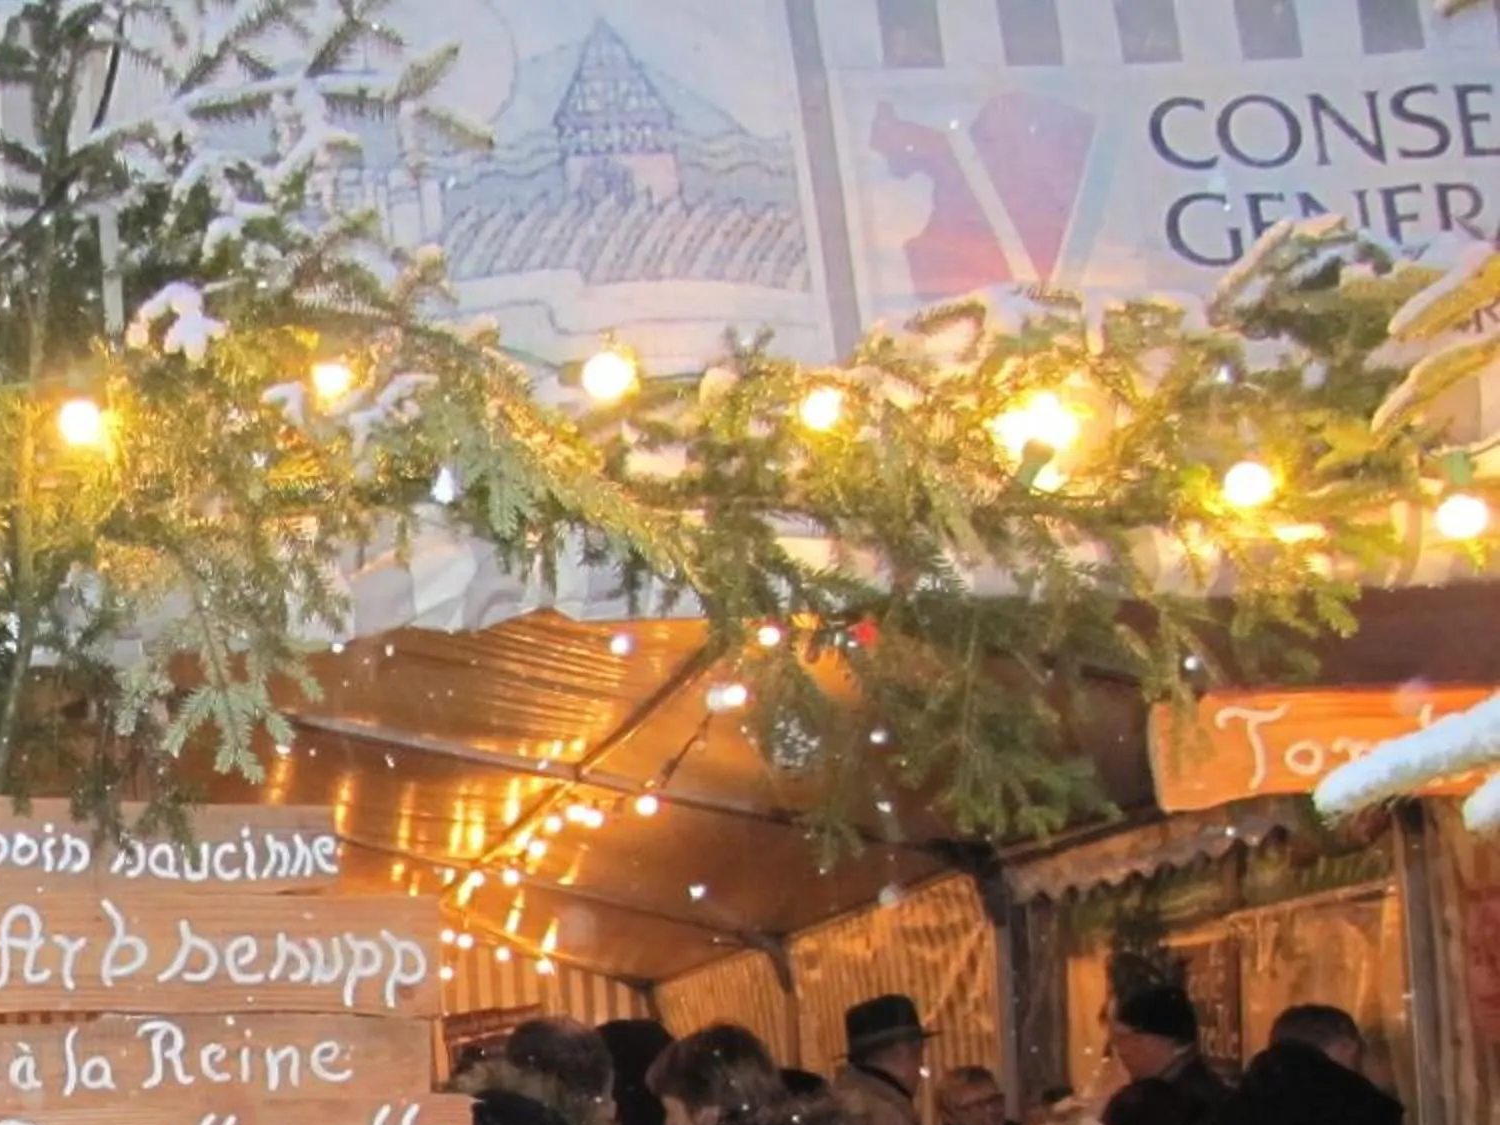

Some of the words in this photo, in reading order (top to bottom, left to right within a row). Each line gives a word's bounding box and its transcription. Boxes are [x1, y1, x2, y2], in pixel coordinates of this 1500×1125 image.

[9, 1043, 43, 1090] à
[63, 1026, 118, 1096] la
[137, 1020, 354, 1092] Reine
